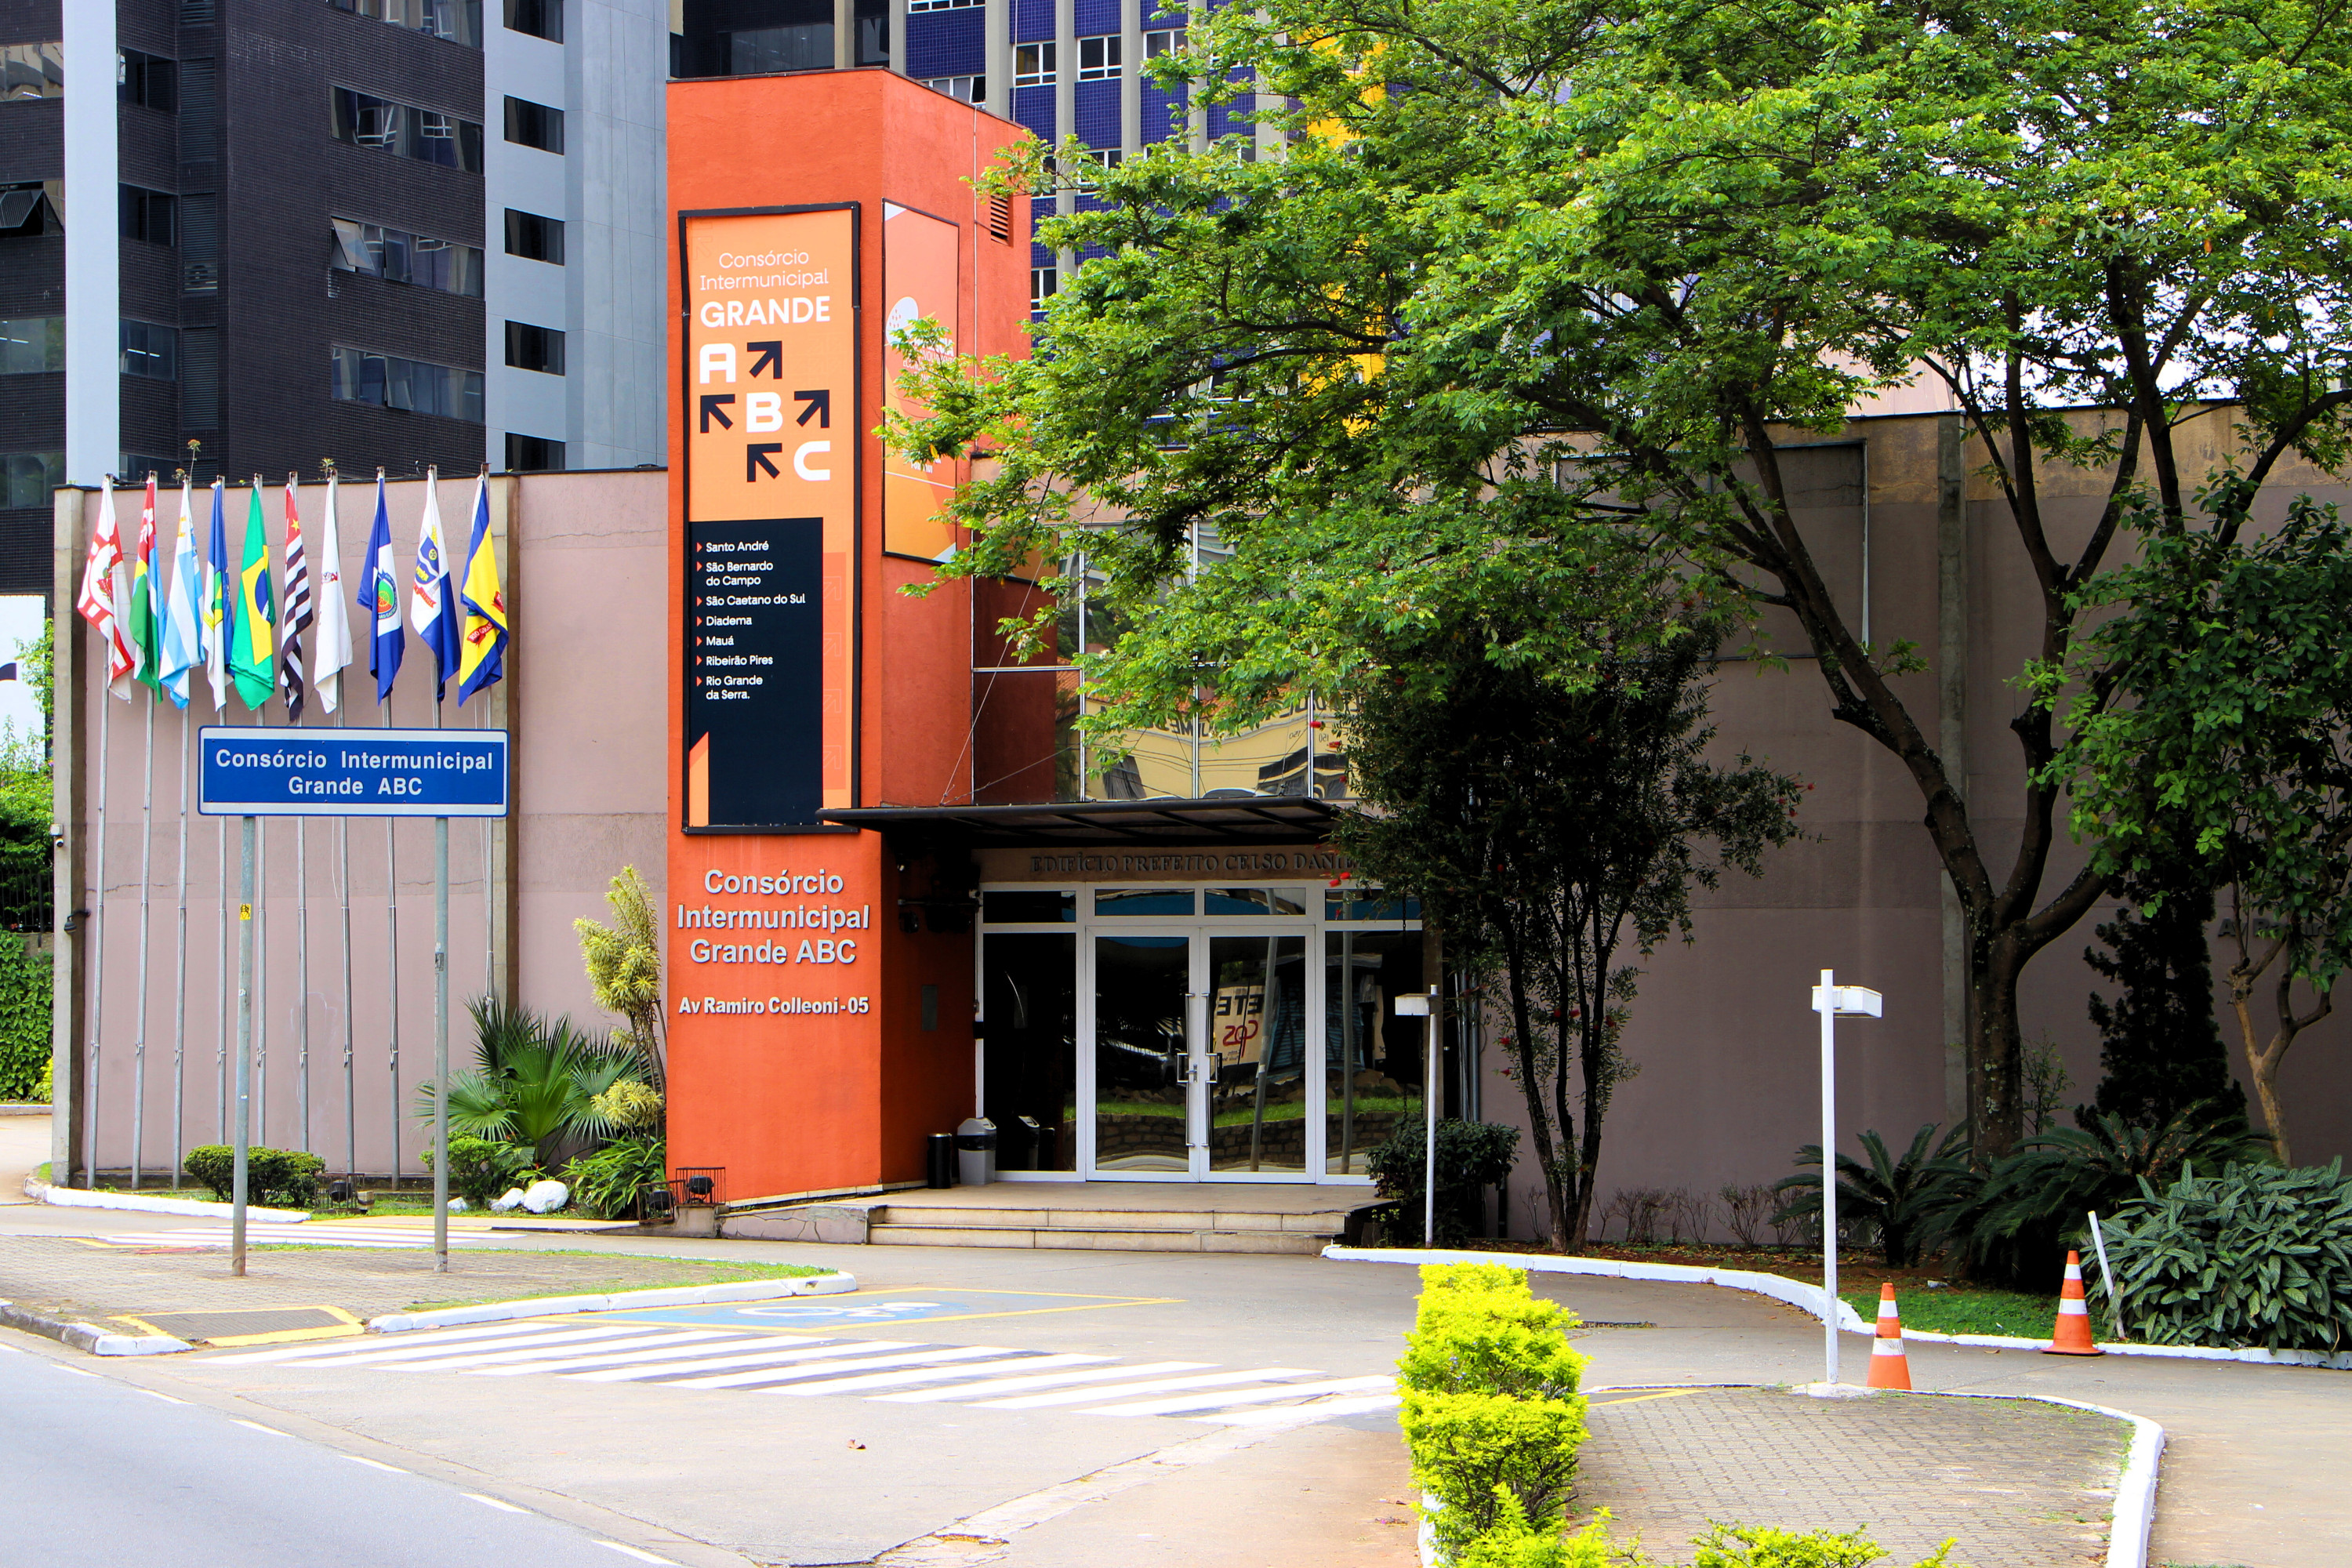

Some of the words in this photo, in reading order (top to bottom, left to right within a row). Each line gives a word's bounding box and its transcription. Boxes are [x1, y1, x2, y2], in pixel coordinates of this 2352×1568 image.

[719, 249, 809, 268] Consórcio
[699, 267, 829, 290] Intermunicipal
[700, 296, 831, 328] GRANDE
[699, 343, 736, 384] A
[746, 392, 783, 433] B
[793, 441, 830, 481] C
[706, 543, 735, 552] Santo
[738, 541, 768, 551] André
[706, 562, 724, 572] São
[728, 561, 773, 571] Bernardo
[706, 576, 720, 586] do
[723, 576, 760, 587] Campo
[706, 597, 724, 605] São
[727, 596, 771, 605] Caetano
[774, 594, 787, 604] do
[790, 593, 805, 604] Sul
[706, 615, 752, 626] Diadema
[706, 636, 734, 645] Mauá
[706, 655, 747, 666] Ribeirão
[750, 655, 773, 665] Pires
[706, 676, 721, 685] Rio
[724, 675, 763, 685] Grande
[706, 690, 719, 699] da
[722, 690, 750, 699] Serra.
[216, 750, 326, 768] Consórcio
[342, 751, 492, 773] Intermunicipal
[289, 777, 362, 793] Grande
[378, 778, 421, 794] ABC
[1030, 852, 1118, 872] EDIFÍCIO
[1122, 855, 1218, 871] PREFEITO
[1223, 854, 1287, 870] CELSO
[1293, 854, 1359, 870] DANIE
[705, 869, 843, 894] Consórcio
[678, 905, 869, 933] Intermunicipal
[691, 939, 786, 963] Grande
[795, 939, 855, 963] ABC
[679, 997, 700, 1013] Av
[704, 997, 764, 1013] Ramiro
[768, 997, 837, 1013] Colleoni
[848, 997, 868, 1013] 05
